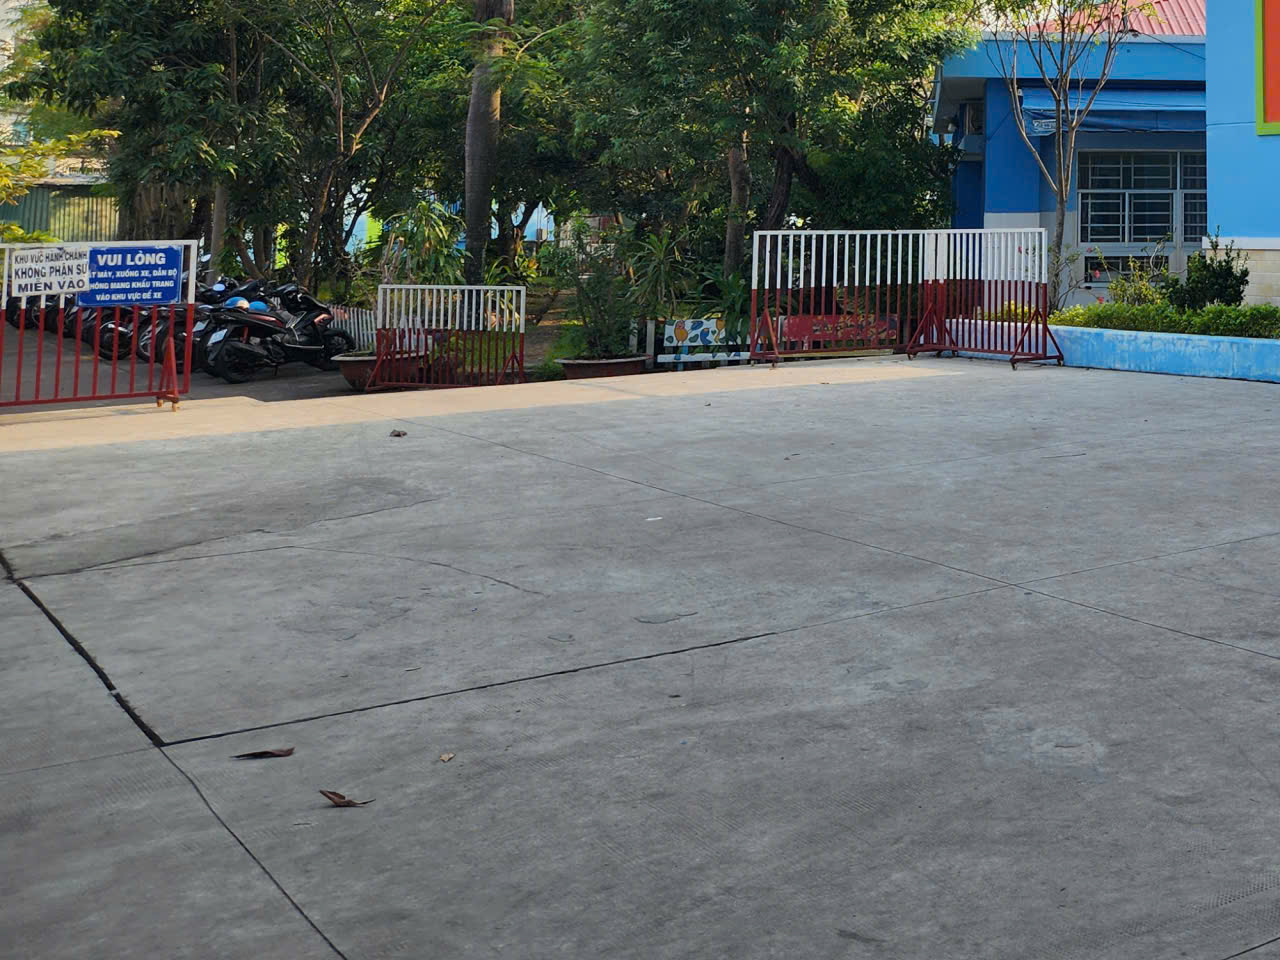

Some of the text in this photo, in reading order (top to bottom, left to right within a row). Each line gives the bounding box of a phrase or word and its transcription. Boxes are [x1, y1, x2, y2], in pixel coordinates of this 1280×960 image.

[97, 250, 166, 266] VUI LÒNG
[57, 277, 85, 290] VÀO
[89, 281, 109, 289] HÔNG
[152, 280, 175, 288] TRANG
